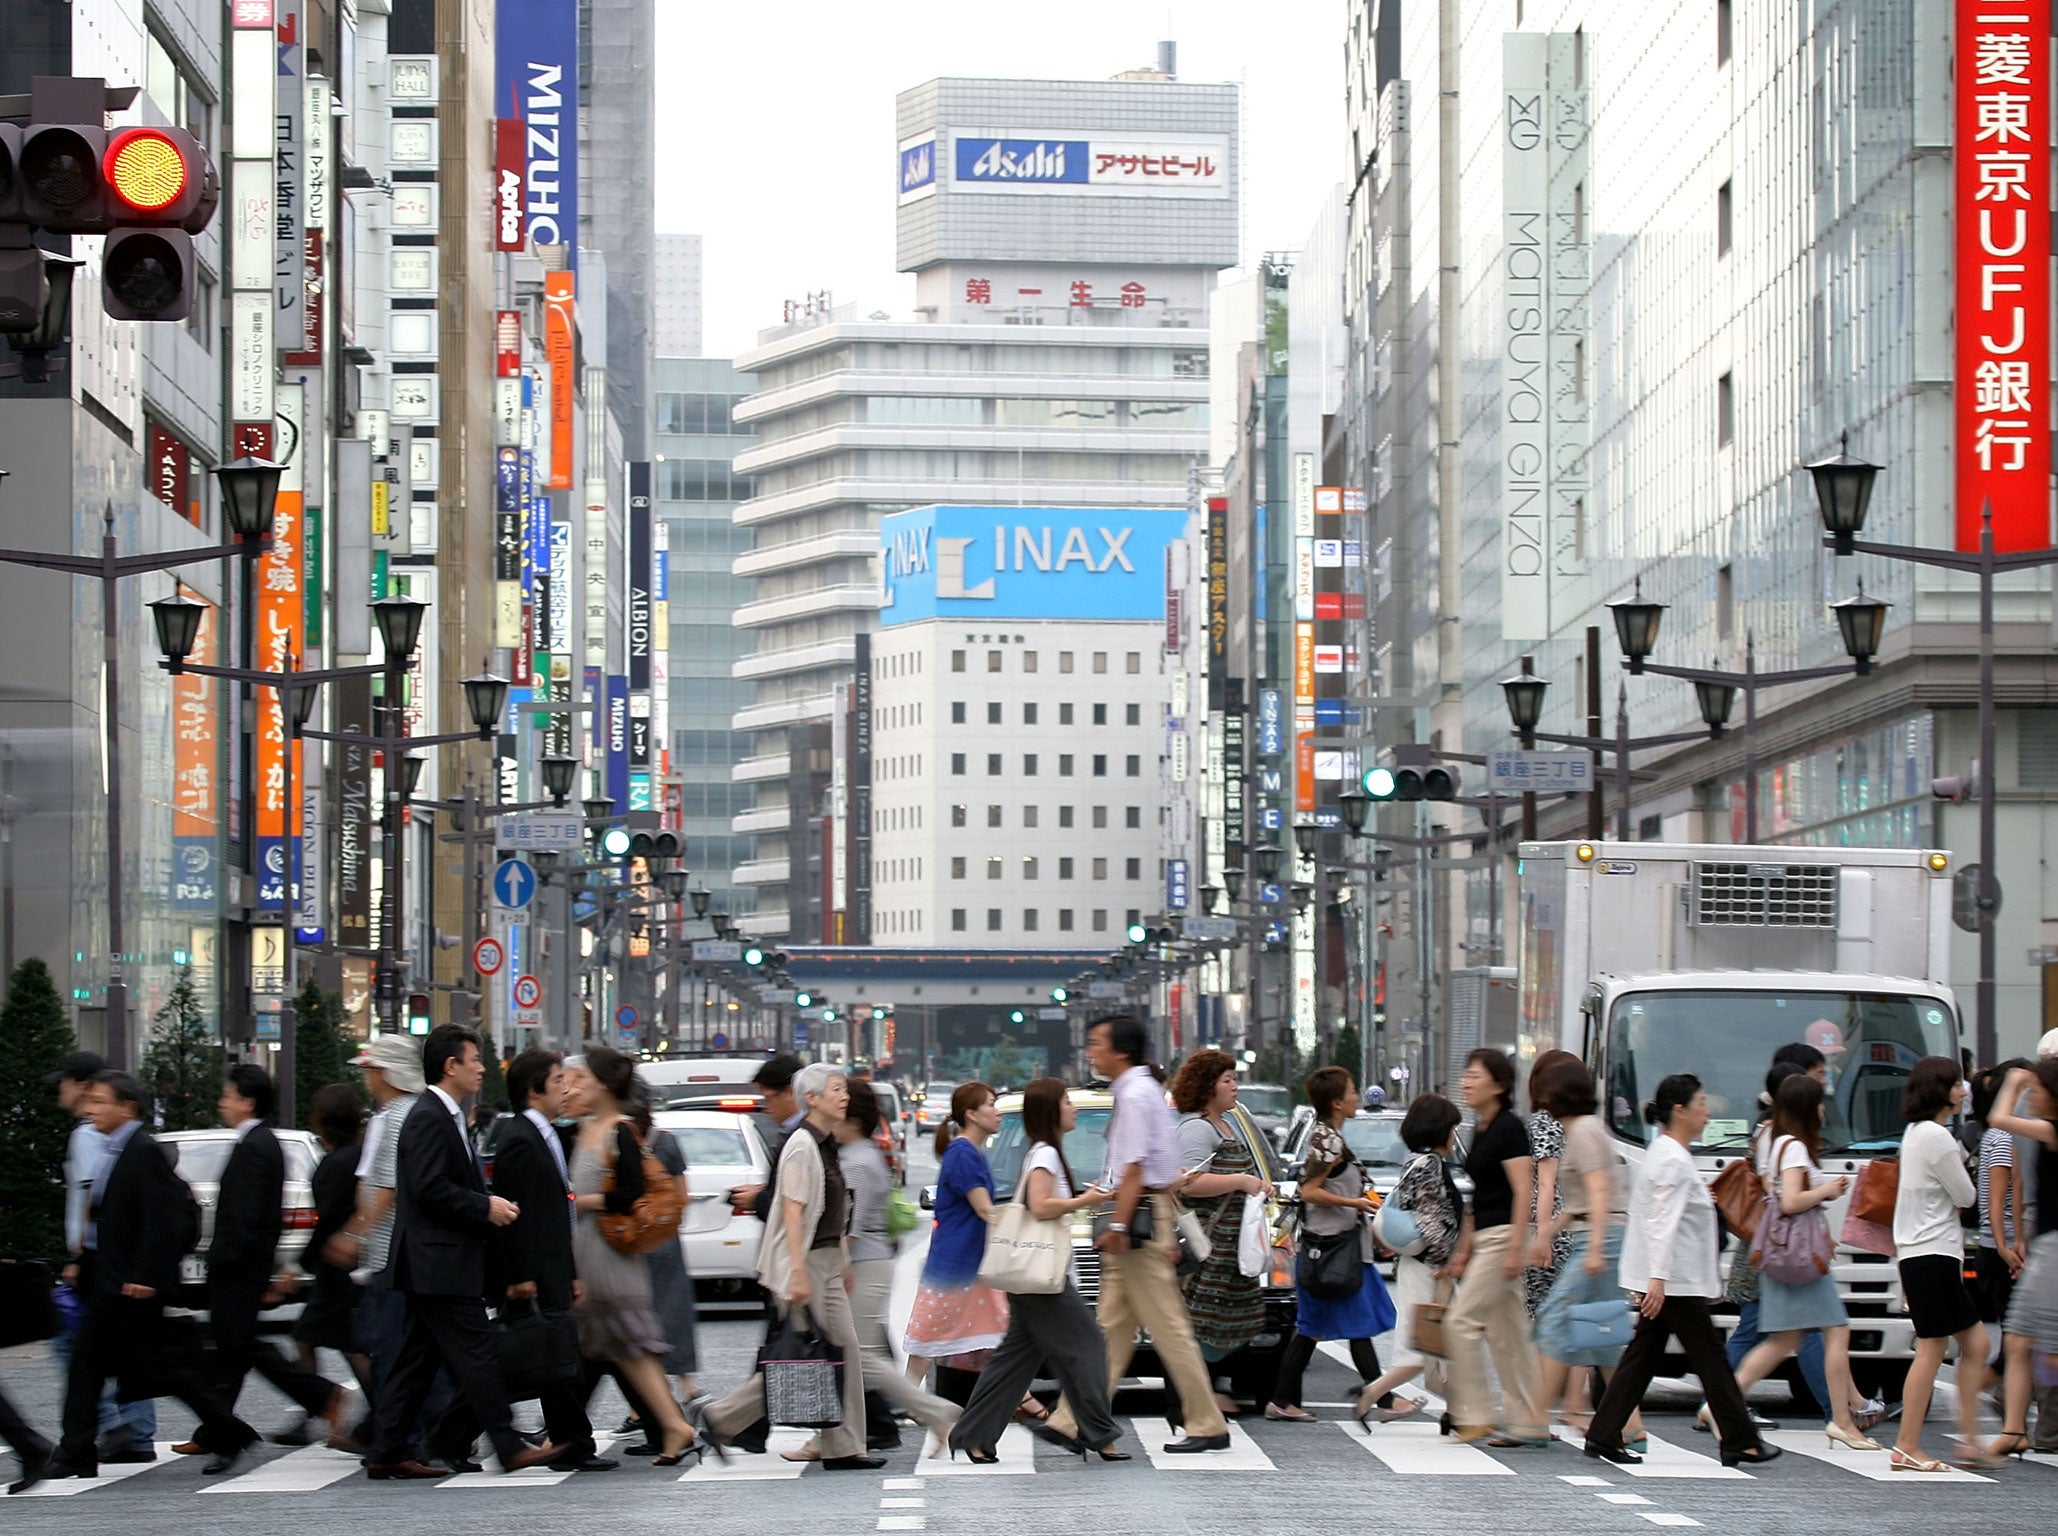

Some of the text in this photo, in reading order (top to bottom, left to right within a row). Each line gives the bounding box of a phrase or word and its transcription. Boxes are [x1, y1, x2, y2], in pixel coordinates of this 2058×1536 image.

[973, 141, 1066, 179] Asahi
[1096, 154, 1216, 177] アサヒビール
[966, 279, 1146, 308] 第一生命
[1508, 443, 1542, 577] GINZA
[891, 526, 931, 578] INAX
[995, 525, 1135, 573] INAX
[631, 587, 648, 656] ALBION
[611, 697, 624, 752] MIZUHO
[1496, 762, 1585, 777] 銀座三丁目
[305, 796, 316, 853] MOON
[503, 825, 577, 838] 銀座三丁目
[480, 949, 497, 965] 50
